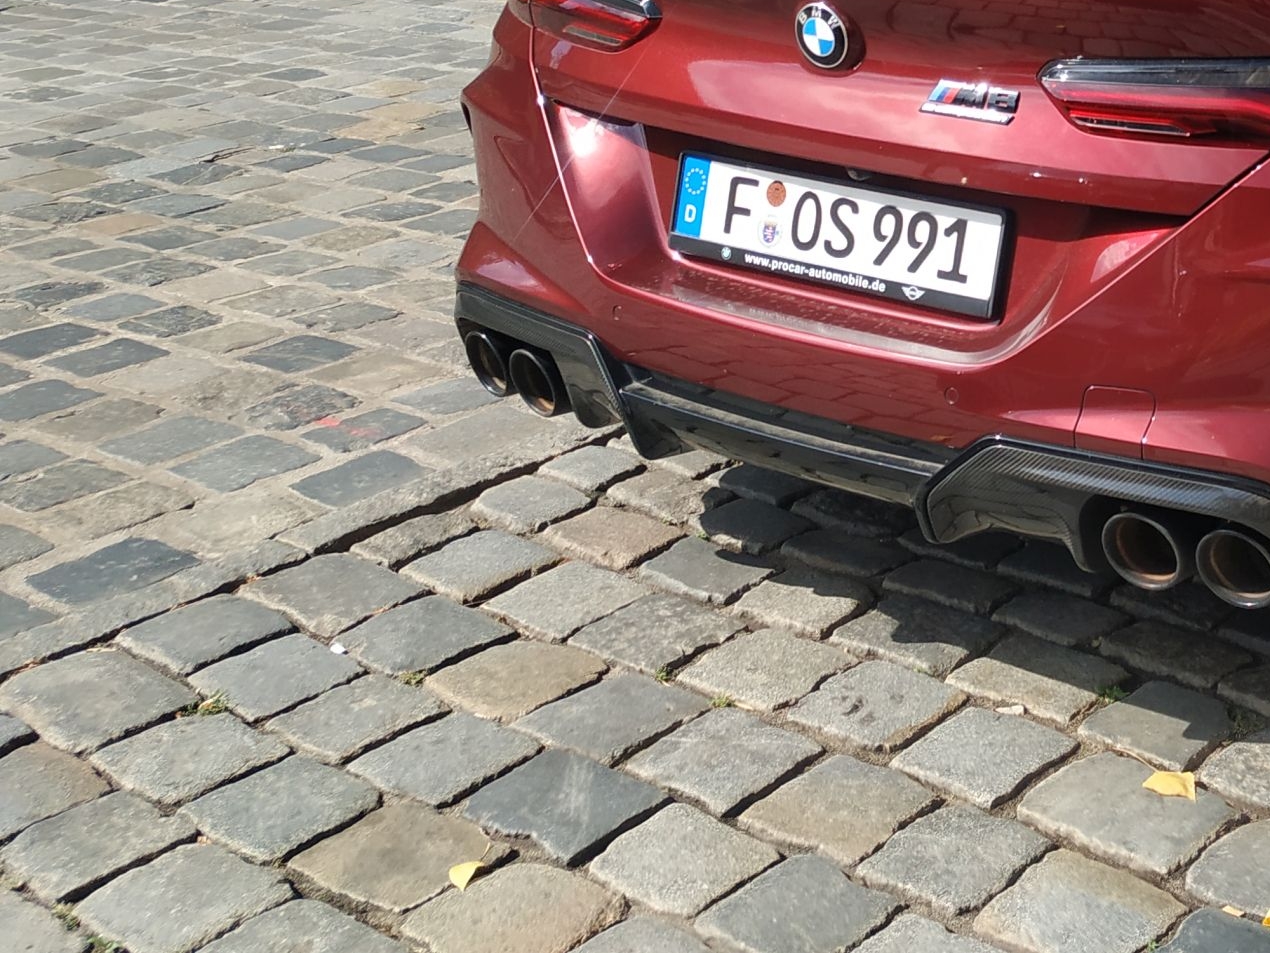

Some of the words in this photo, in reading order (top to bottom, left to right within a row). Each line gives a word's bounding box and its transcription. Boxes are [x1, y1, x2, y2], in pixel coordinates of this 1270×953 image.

[799, 5, 841, 30] BMW
[683, 204, 698, 223] D
[722, 175, 760, 235] F
[791, 190, 860, 259] OS
[872, 204, 969, 284] 991
[744, 251, 887, 293] www.procar-automobile.de
